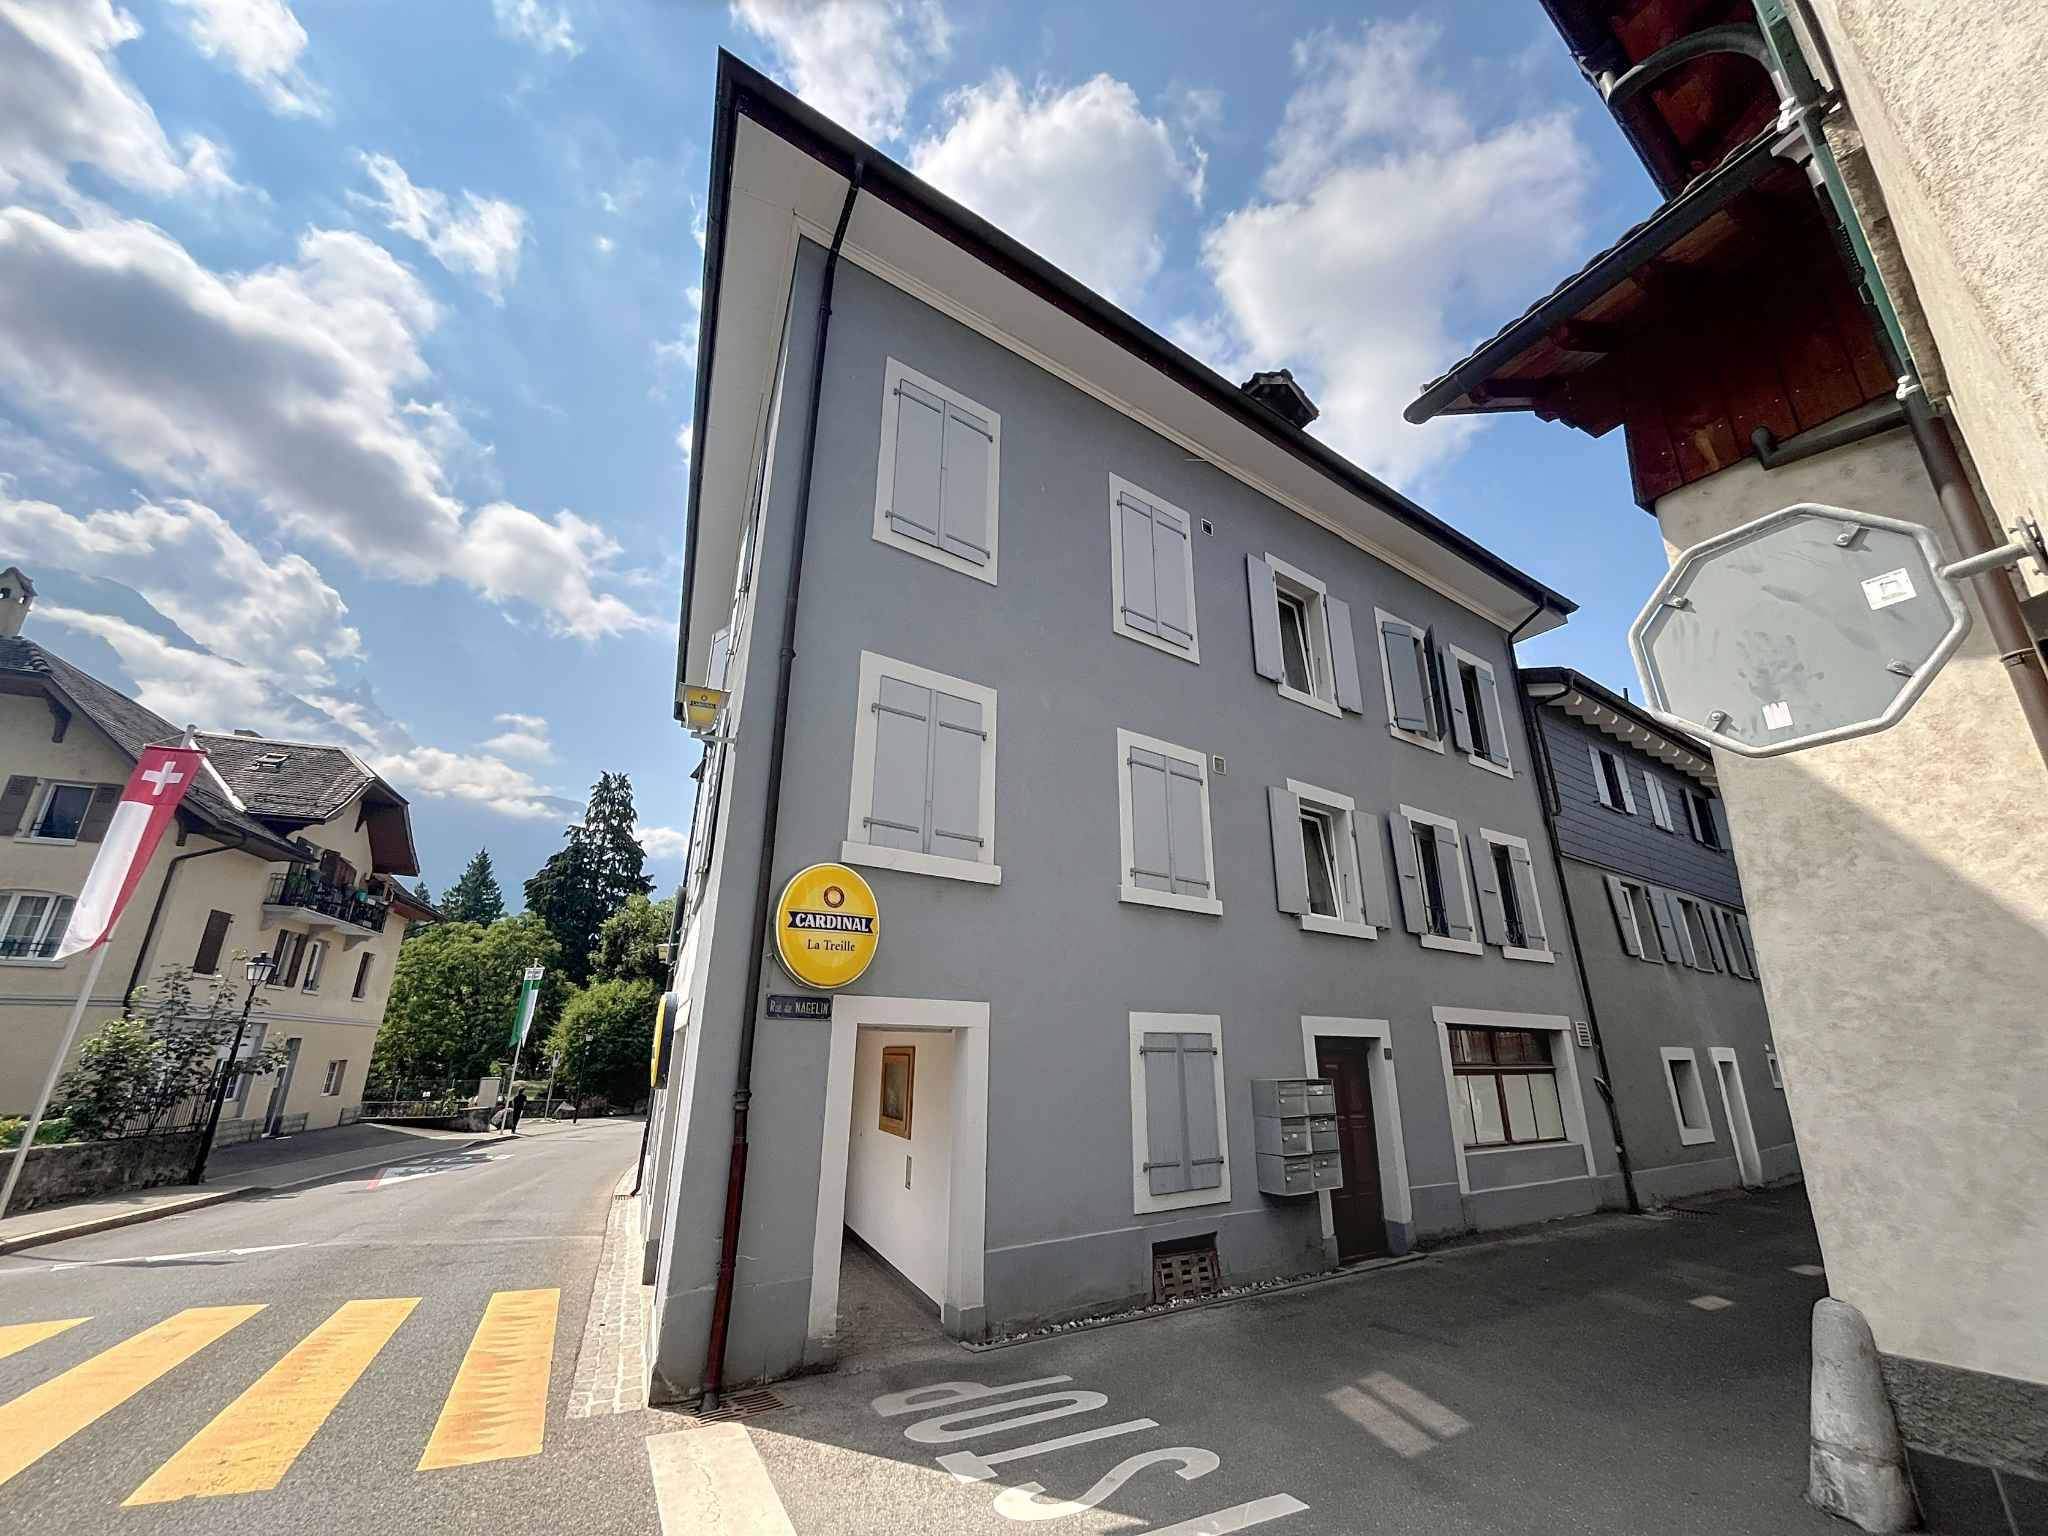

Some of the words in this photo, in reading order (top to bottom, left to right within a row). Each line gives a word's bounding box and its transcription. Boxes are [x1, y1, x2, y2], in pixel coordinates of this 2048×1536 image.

[795, 913, 869, 932] CARDINAL
[807, 939, 820, 950] La
[824, 940, 856, 952] Treille
[873, 1375, 1221, 1521] STOP
